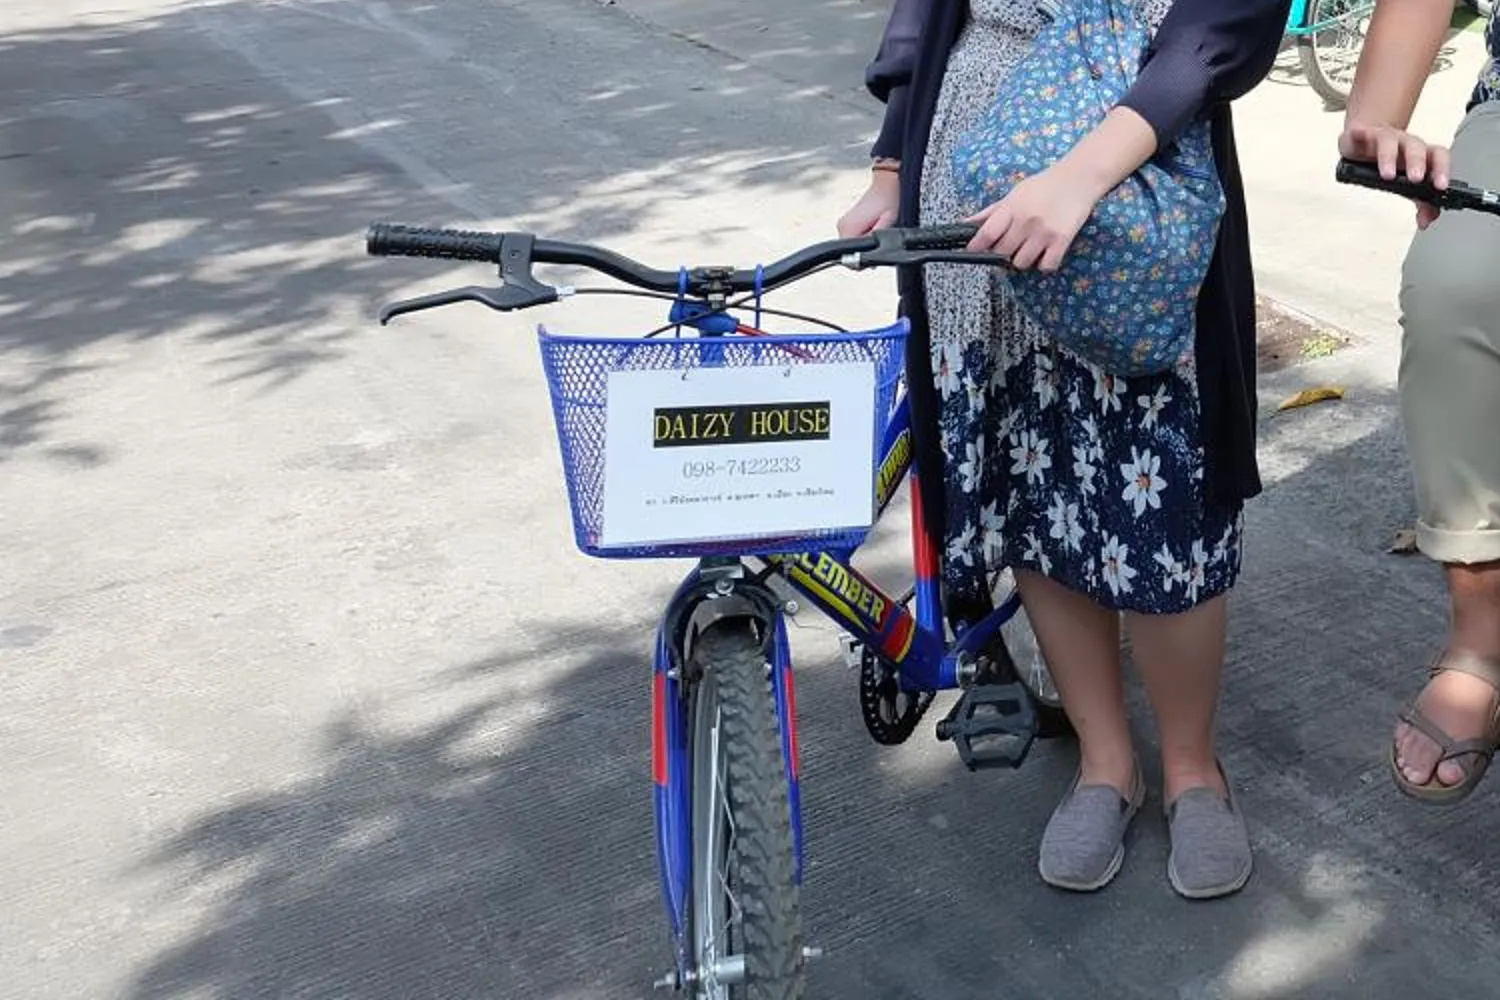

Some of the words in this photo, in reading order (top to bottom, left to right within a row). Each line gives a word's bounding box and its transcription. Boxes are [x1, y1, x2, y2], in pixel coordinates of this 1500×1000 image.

[654, 411, 735, 441] DAIZY
[751, 407, 830, 436] HOUSE
[682, 455, 802, 479] 098-7422233
